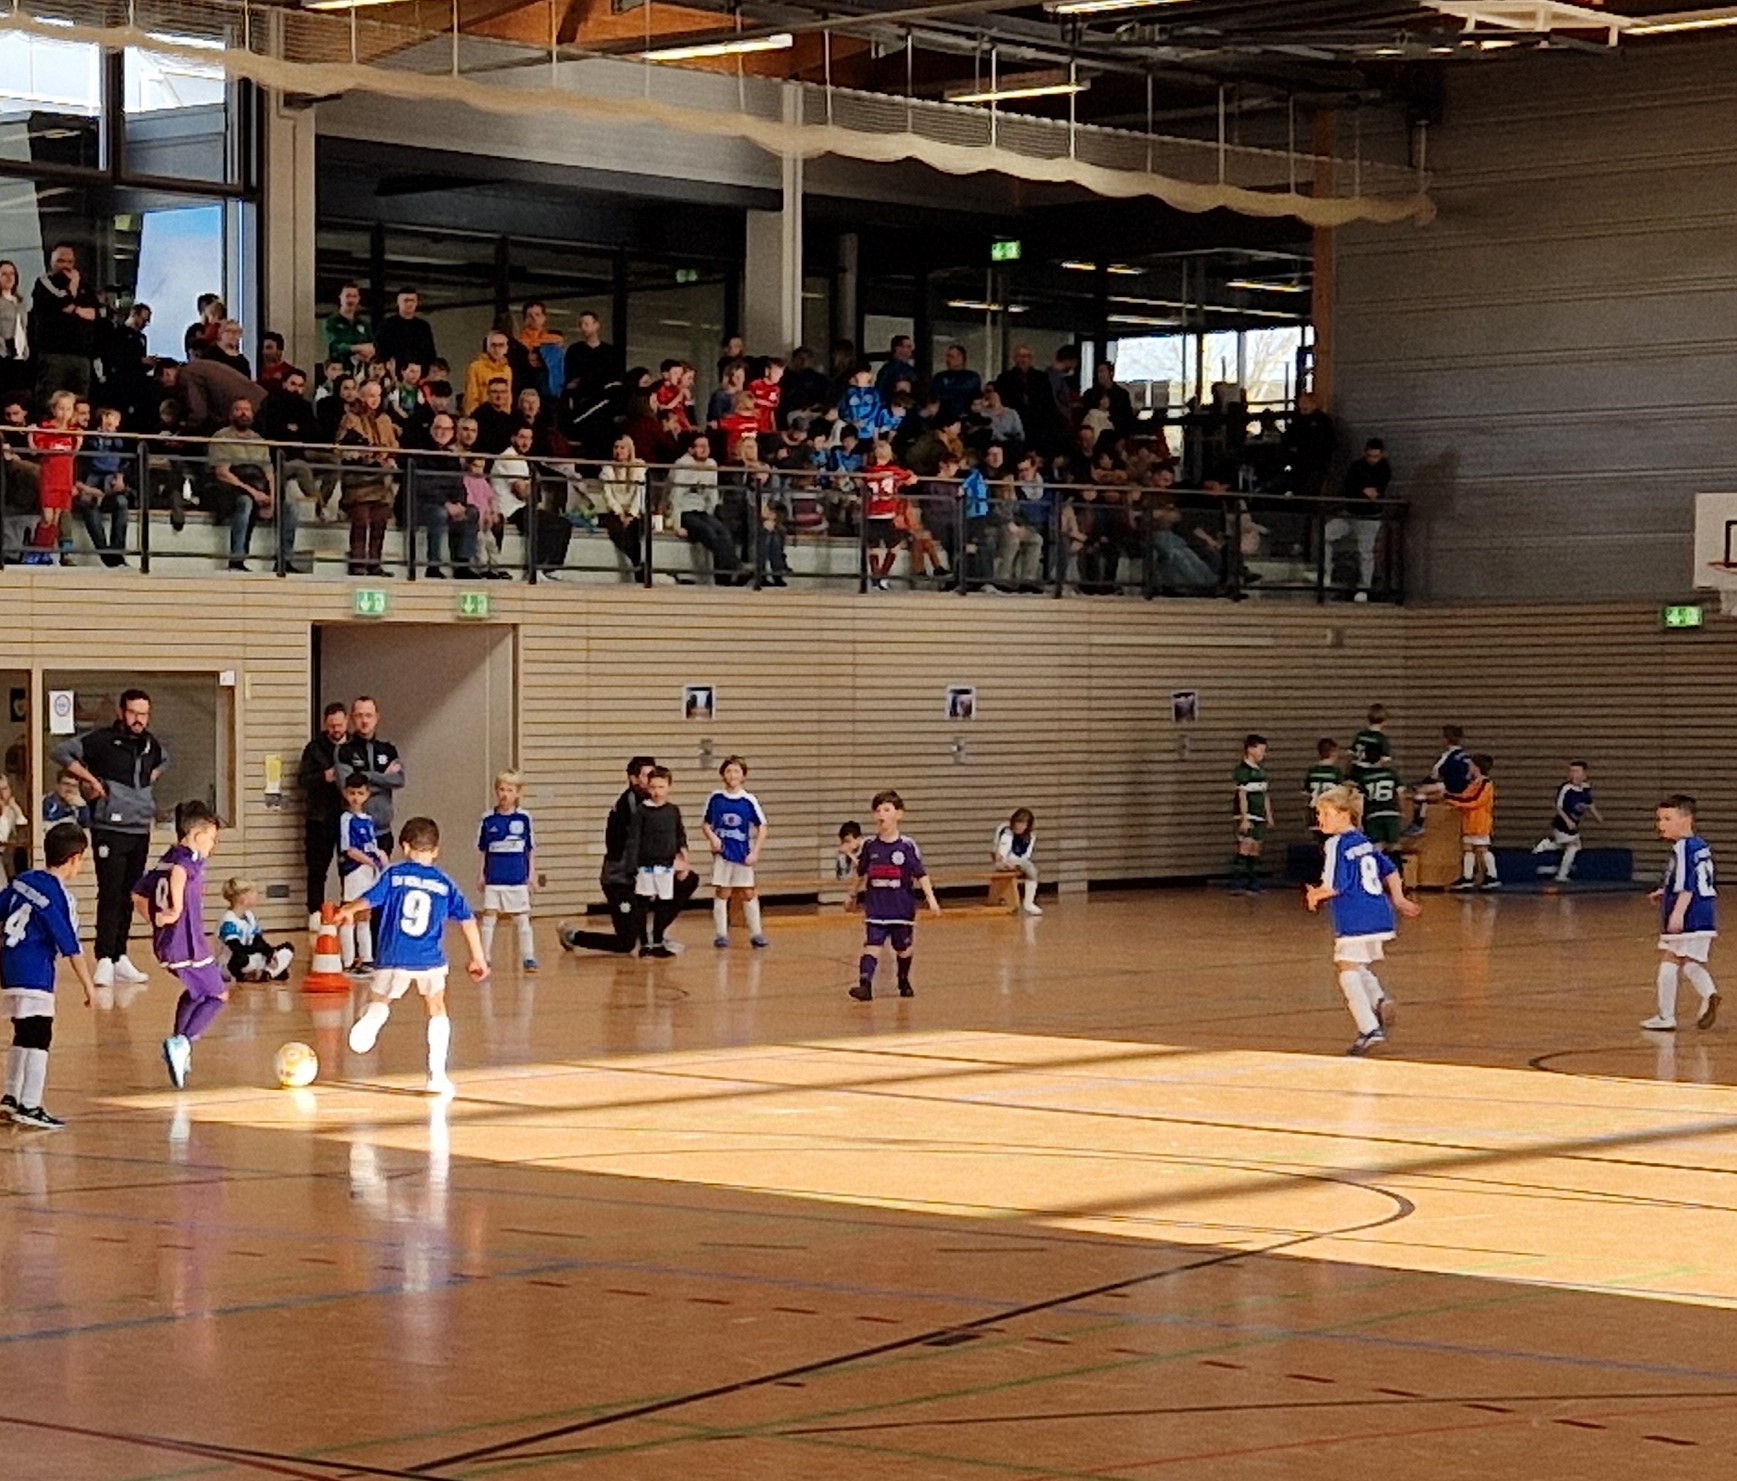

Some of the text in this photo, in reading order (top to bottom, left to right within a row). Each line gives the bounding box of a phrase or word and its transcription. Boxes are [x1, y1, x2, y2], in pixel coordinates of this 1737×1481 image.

[1365, 780, 1395, 801] 16
[1360, 855, 1383, 895] 8
[4, 902, 33, 948] 4
[401, 889, 432, 936] 9
